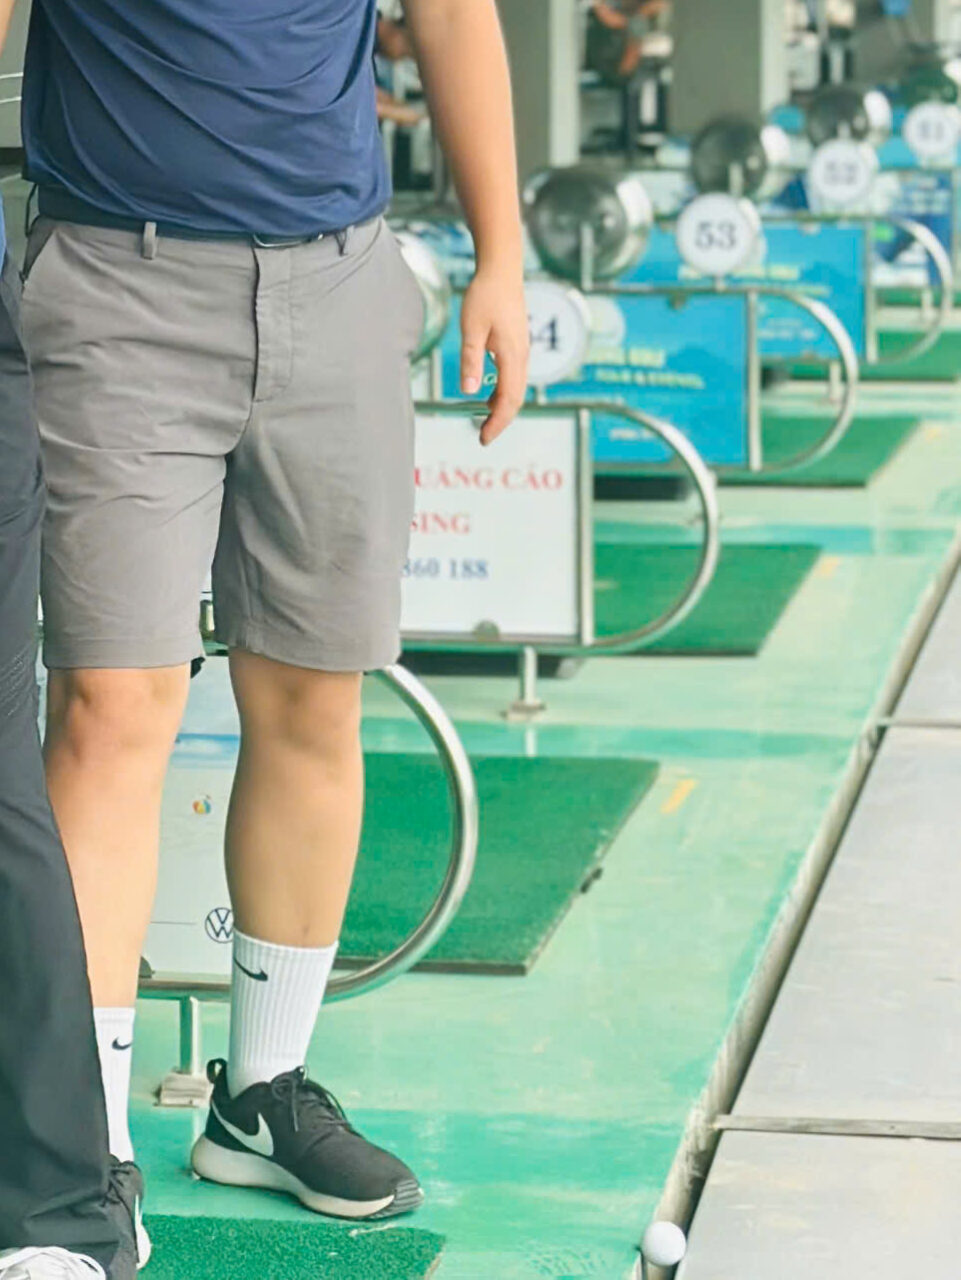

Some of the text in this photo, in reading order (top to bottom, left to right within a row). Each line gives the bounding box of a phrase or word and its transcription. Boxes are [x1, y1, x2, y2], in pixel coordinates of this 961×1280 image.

[695, 221, 736, 251] 53
[527, 314, 560, 352] 4
[449, 558, 489, 581] 188
